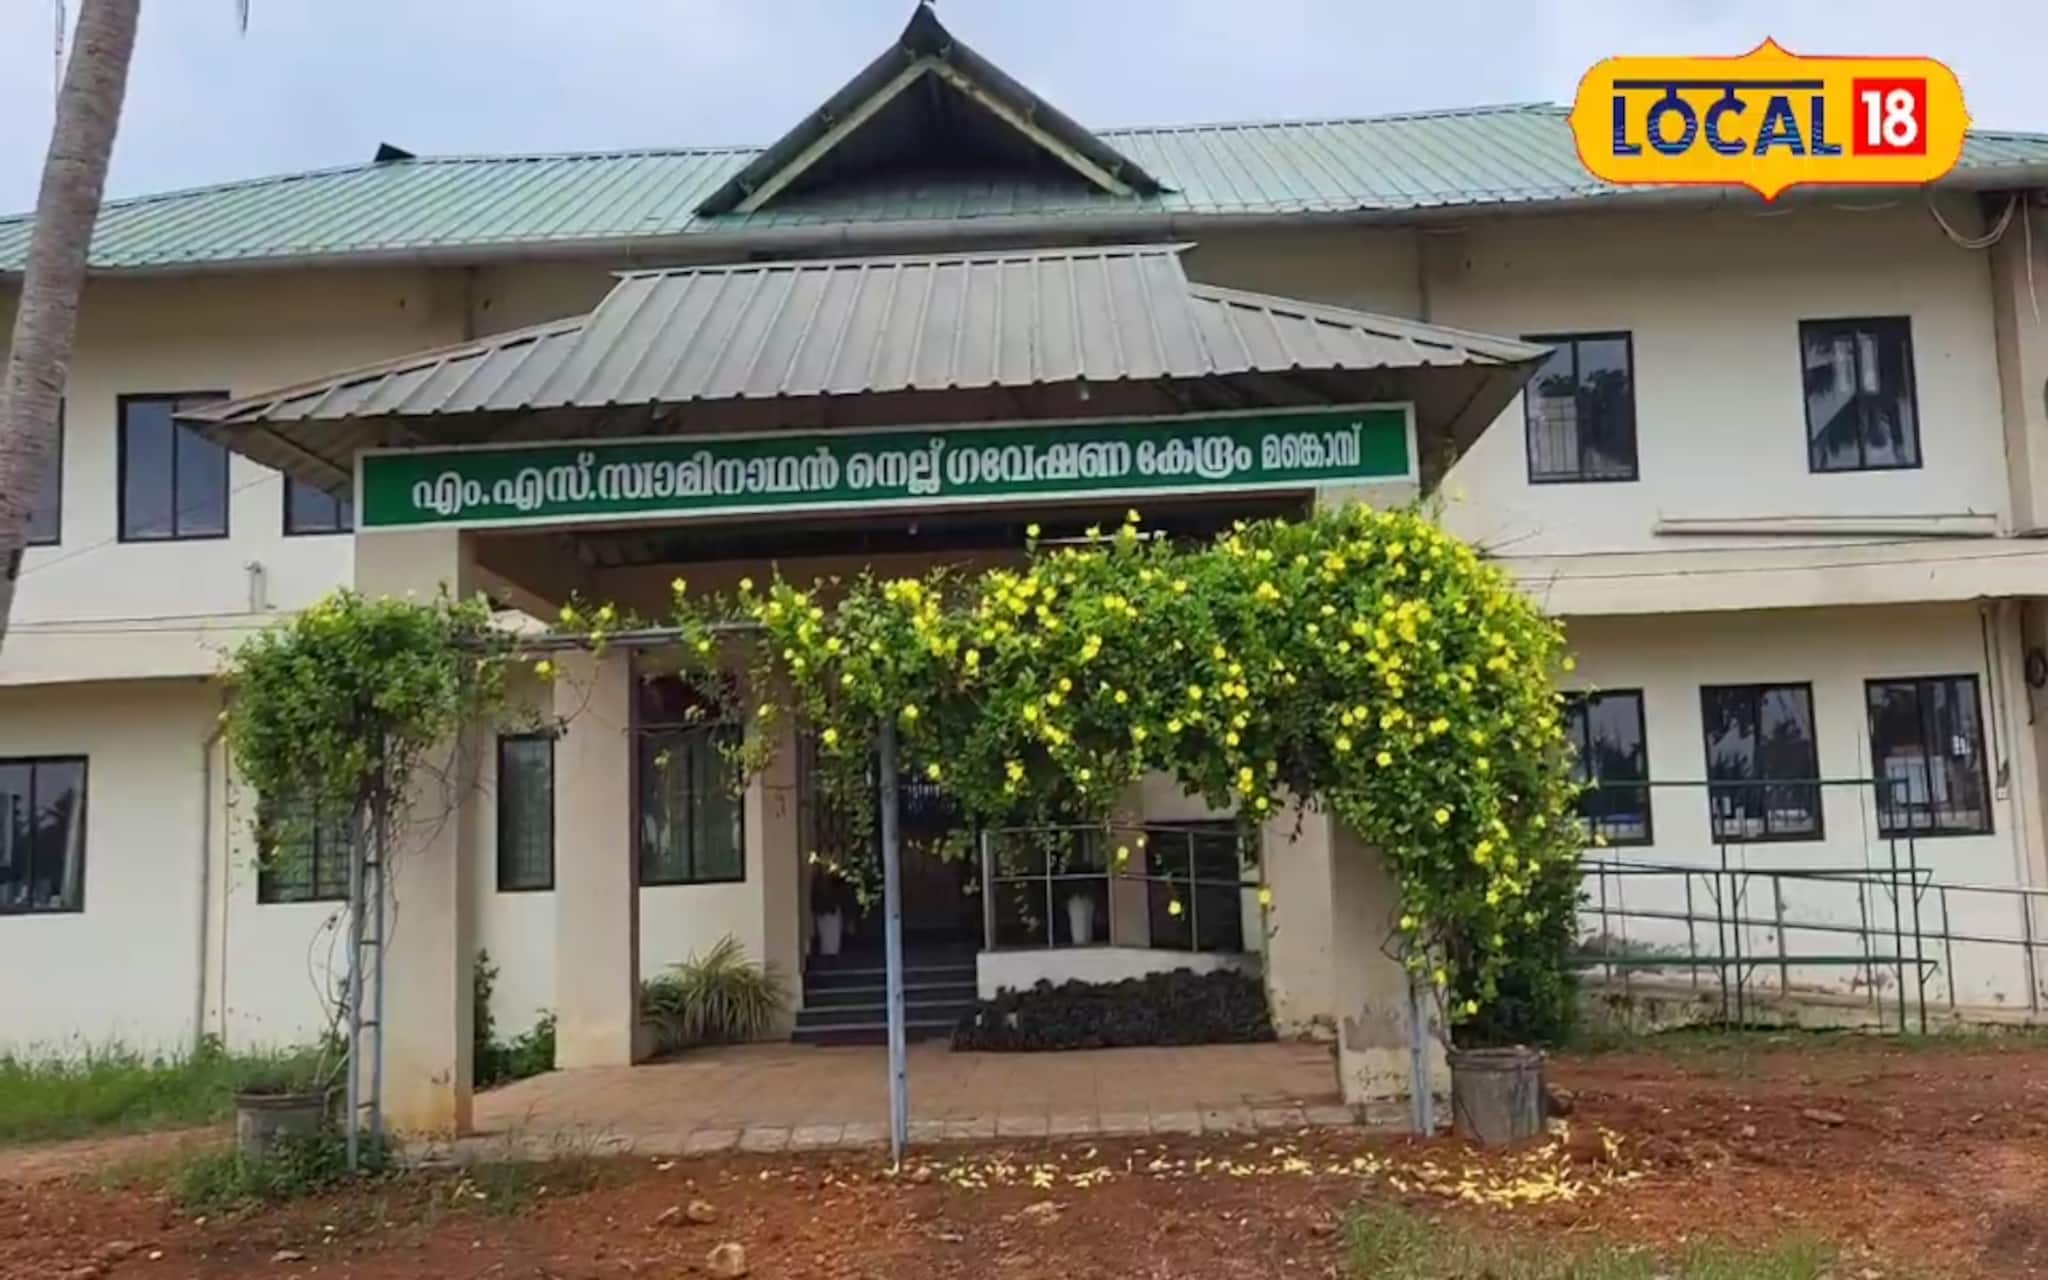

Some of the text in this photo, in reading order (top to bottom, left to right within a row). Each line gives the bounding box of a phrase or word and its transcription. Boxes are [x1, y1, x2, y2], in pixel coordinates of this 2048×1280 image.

[846, 437, 946, 495] നെല്ല്
[946, 441, 1132, 485] ഗവേഷണ
[1136, 434, 1253, 479] കേന്ദ്രം
[1261, 422, 1363, 470] മങ്കൊമ്പ്
